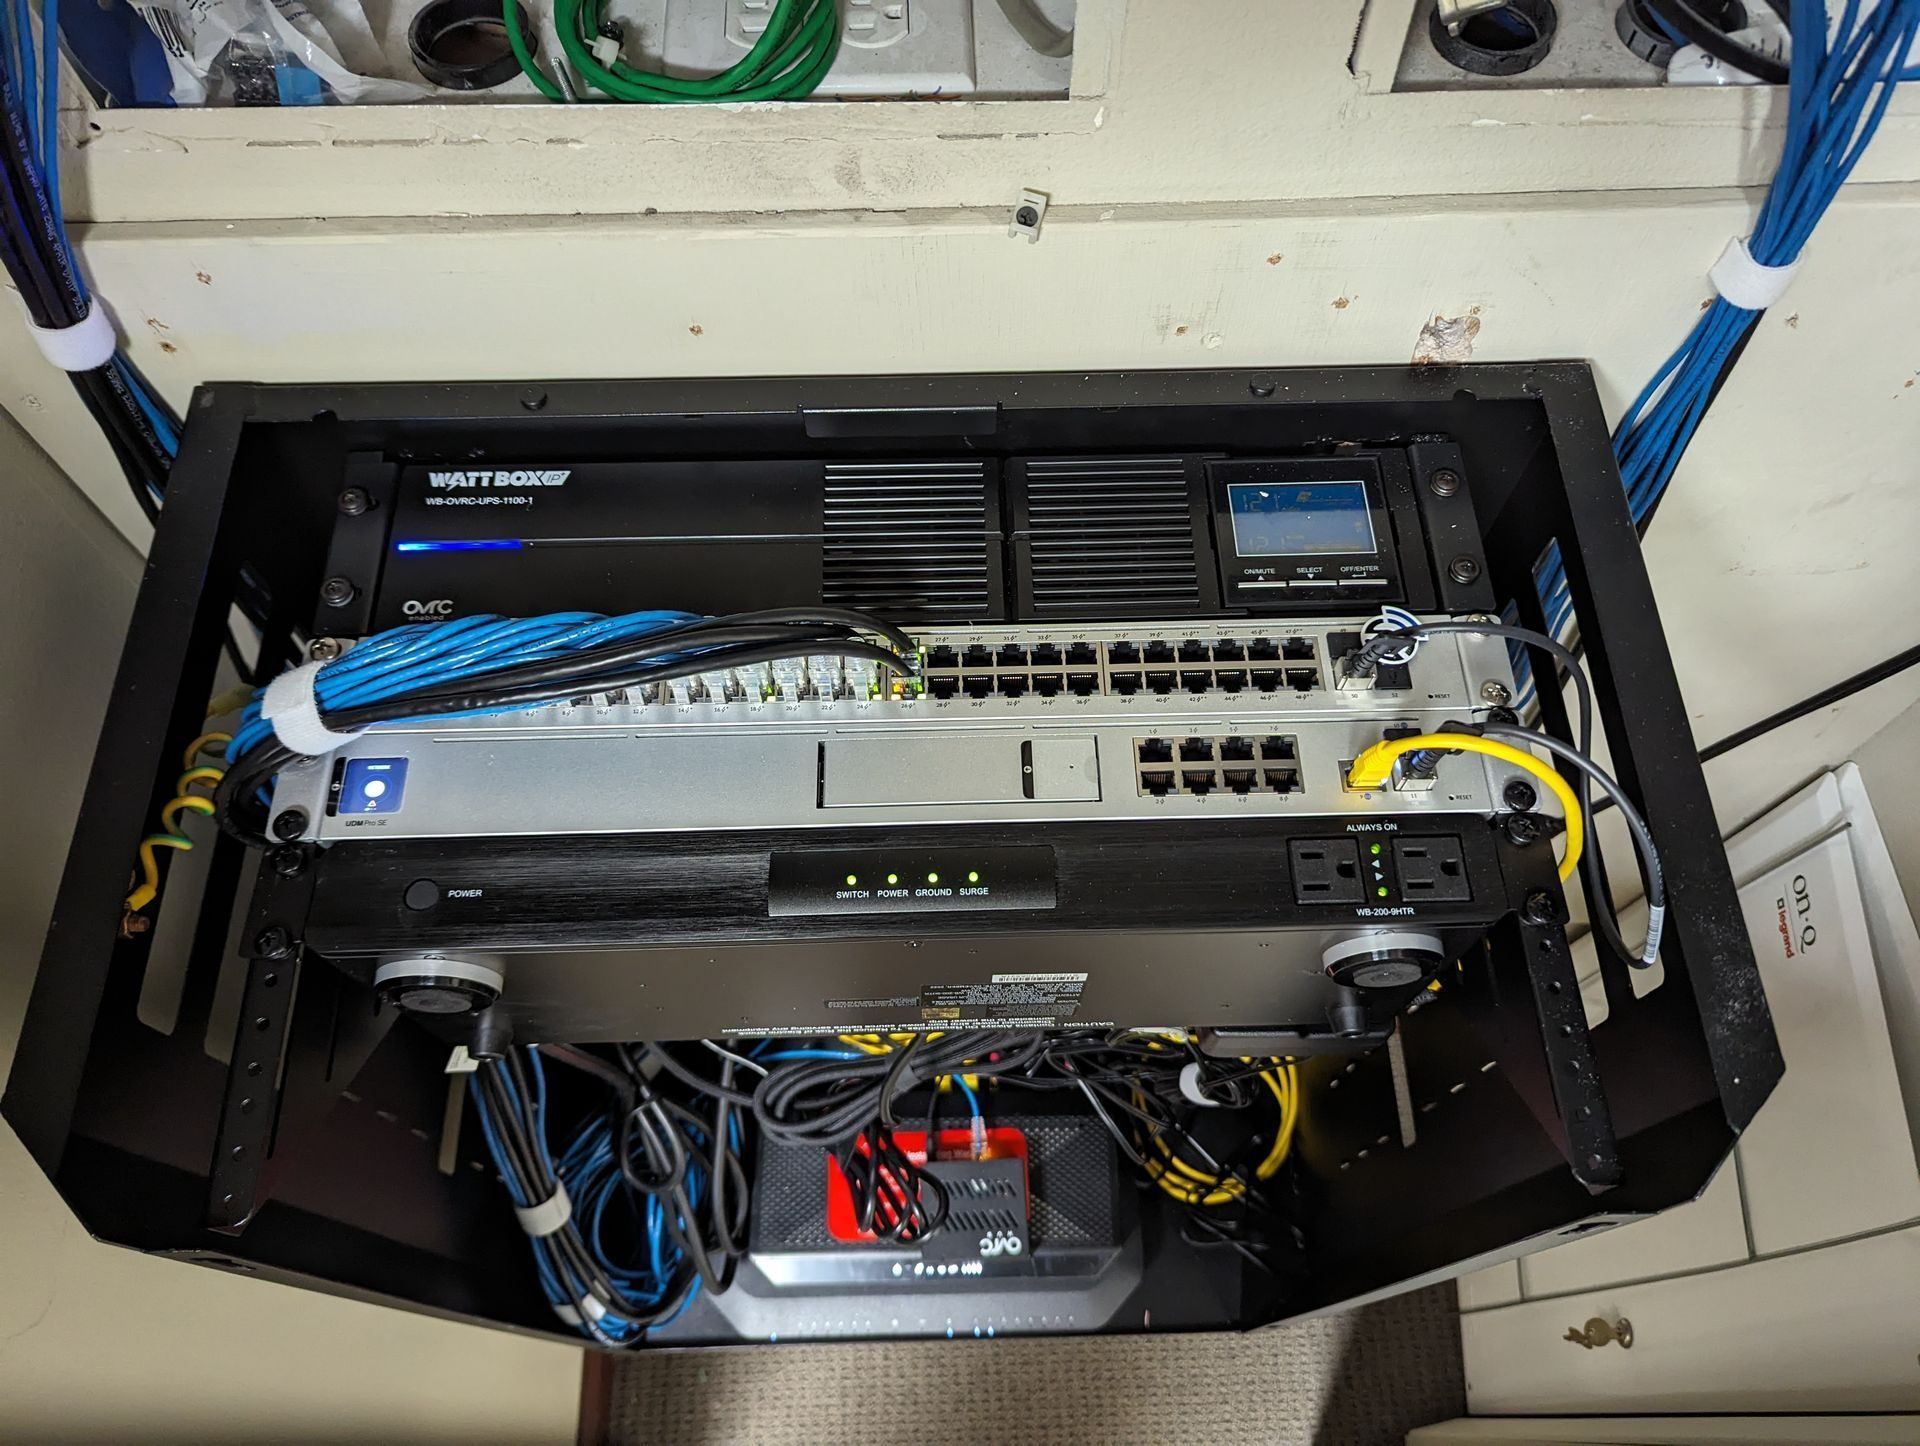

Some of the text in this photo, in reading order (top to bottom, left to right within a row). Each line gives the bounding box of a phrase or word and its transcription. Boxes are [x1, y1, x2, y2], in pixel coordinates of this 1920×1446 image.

[425, 497, 534, 506] WB-OVRC-UPS-1100-1
[1243, 565, 1380, 575] ON/MUTE SELECT OFF/ENTER
[1346, 823, 1398, 832] ALWAYS ON
[447, 889, 483, 898] POWER
[836, 887, 989, 899] SWITCH POWER GROUND SURGE
[1356, 907, 1415, 916] WB-200-9HTR
[1778, 909, 1795, 959] legrand
